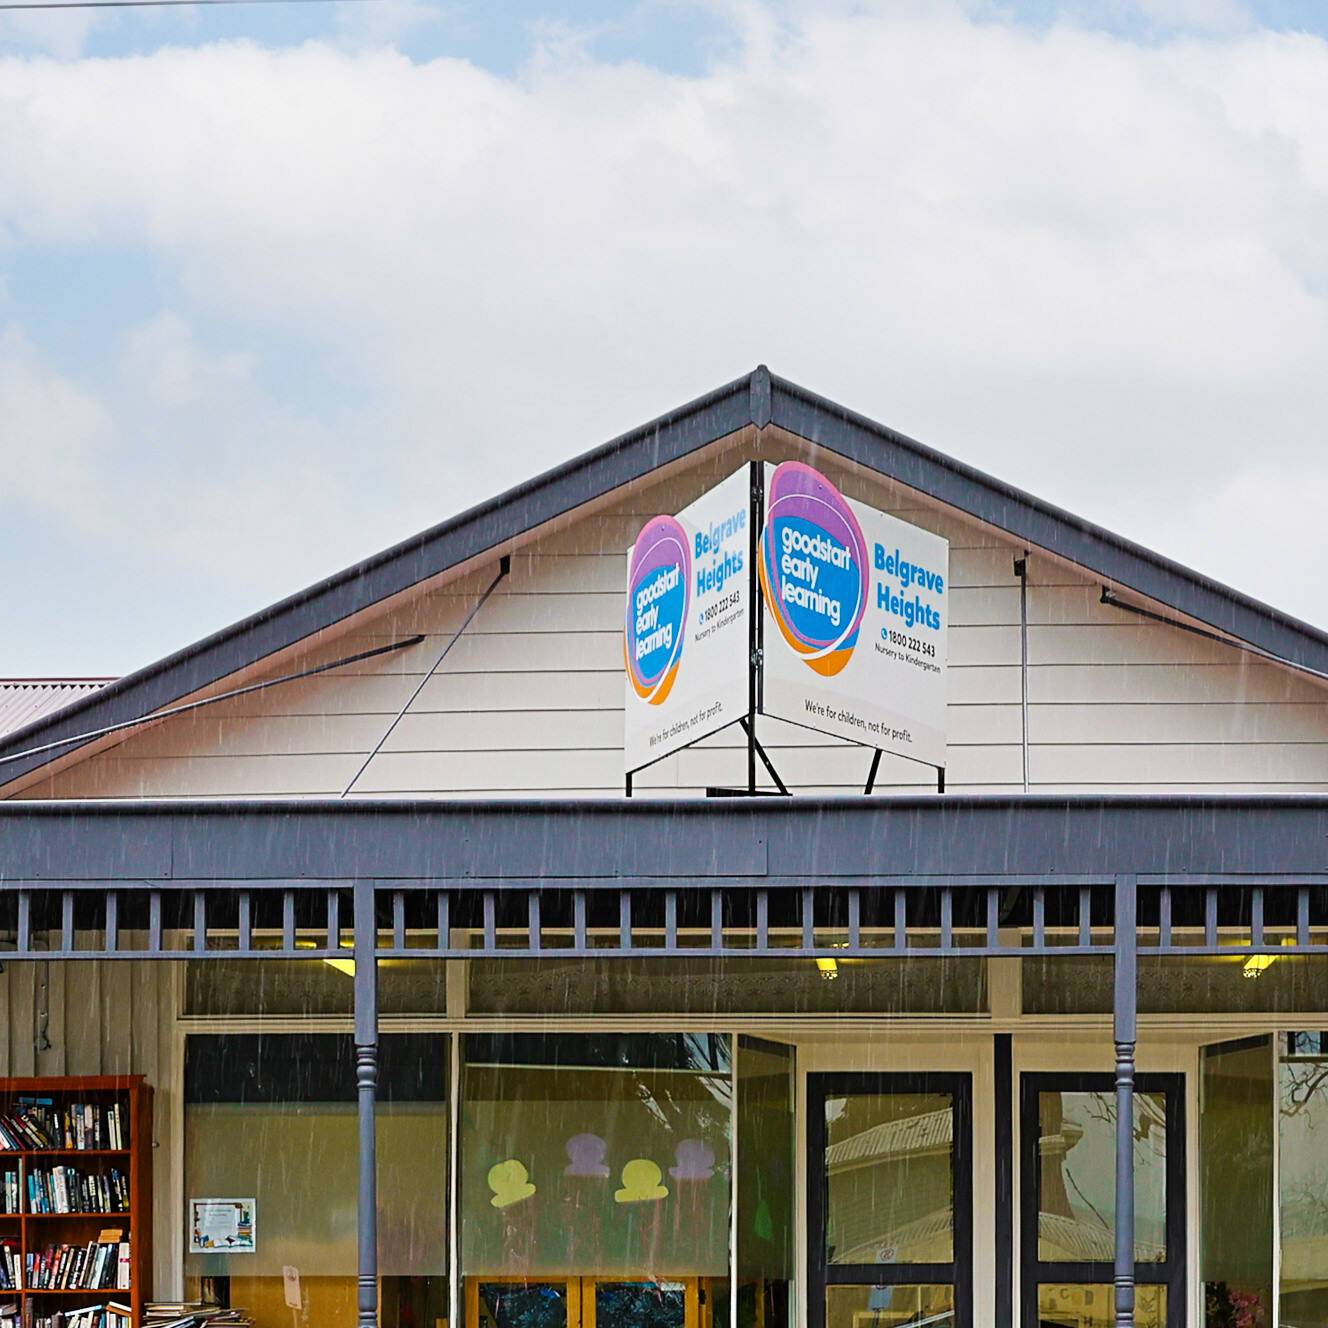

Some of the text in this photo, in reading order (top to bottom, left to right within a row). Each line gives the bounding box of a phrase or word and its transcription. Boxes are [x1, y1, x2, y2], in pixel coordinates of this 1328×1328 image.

[695, 508, 746, 559] Belgrave
[782, 526, 852, 571] goodstart
[636, 563, 680, 615] goodstart
[697, 551, 744, 597] Heights
[782, 553, 819, 589] early
[874, 543, 944, 594] Belgrave
[636, 603, 658, 635] early
[704, 590, 740, 622] 1800 222 543
[782, 575, 842, 627] learning
[877, 582, 940, 630] Heights
[636, 622, 672, 661] learning
[874, 642, 941, 674] Nursery to Kindergarten
[889, 630, 936, 657] 1800 222 543
[662, 728, 670, 741] for
[690, 715, 699, 728] not
[699, 710, 707, 724] for
[805, 699, 913, 743] We're for children, not for profit.
